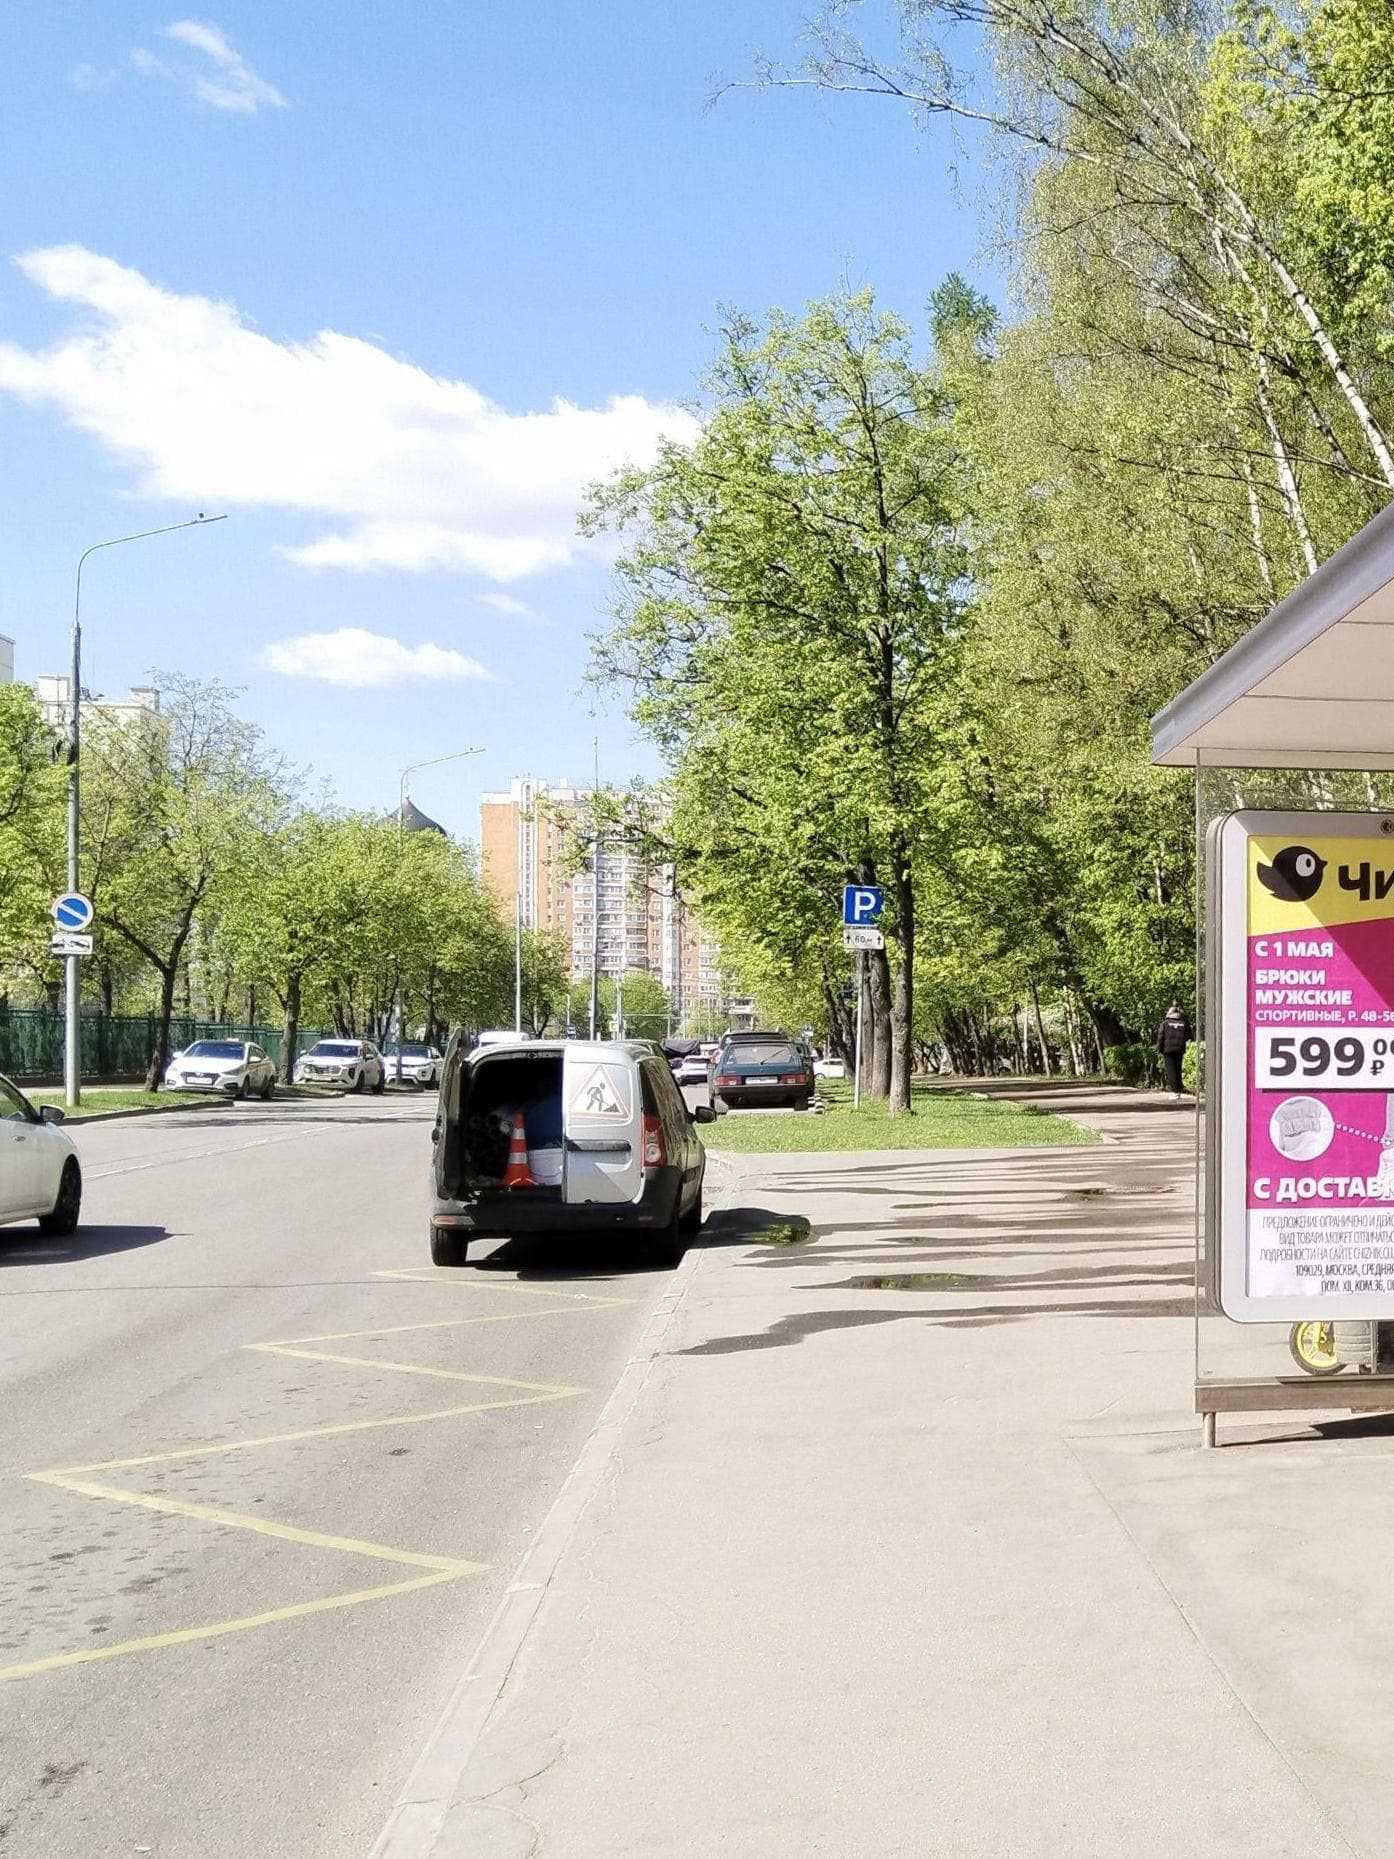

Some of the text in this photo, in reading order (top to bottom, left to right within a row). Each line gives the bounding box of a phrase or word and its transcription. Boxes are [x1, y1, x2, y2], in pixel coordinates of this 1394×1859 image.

[1255, 941, 1334, 958] С 1 МАЯ
[1255, 969, 1326, 985] БРЮКИ
[1255, 989, 1353, 1006] МУЖСКИЕ
[1255, 1010, 1345, 1024] СПОРТИВНЫЕ,
[1348, 1011, 1358, 1021] Р.
[1269, 1036, 1365, 1077] 599
[1253, 1177, 1271, 1199] С
